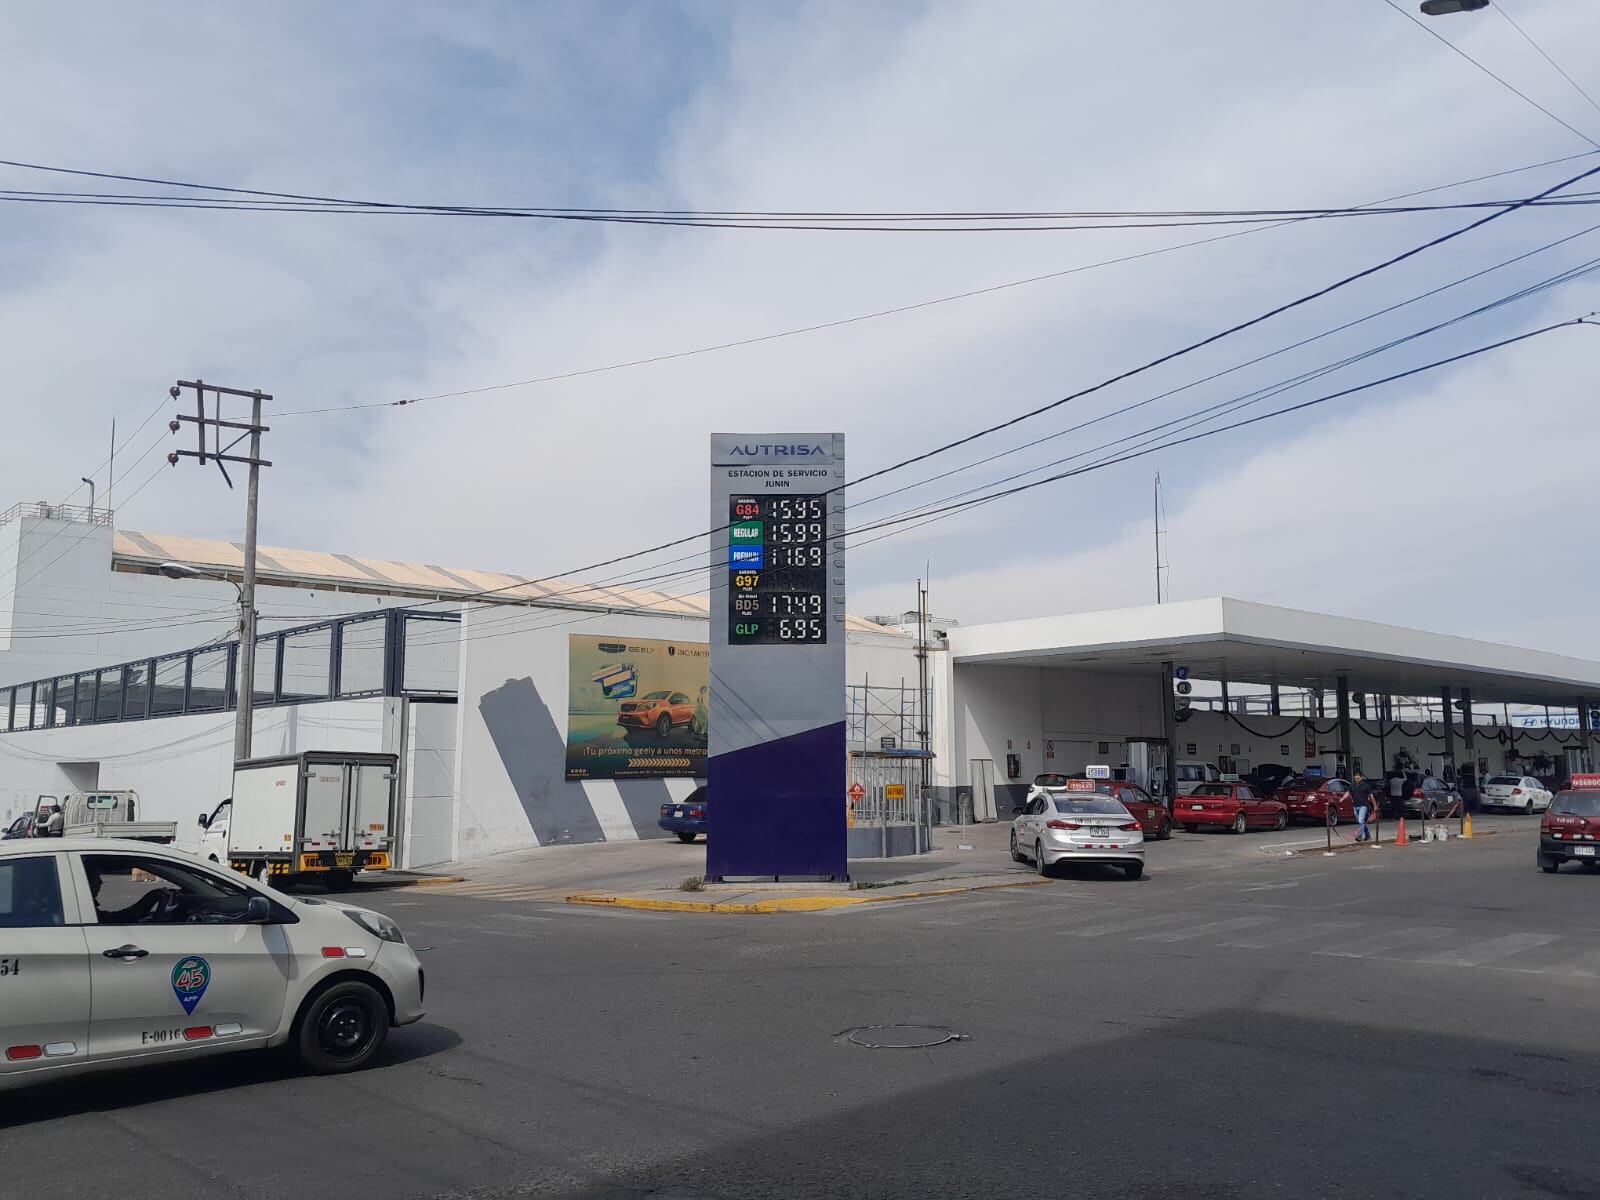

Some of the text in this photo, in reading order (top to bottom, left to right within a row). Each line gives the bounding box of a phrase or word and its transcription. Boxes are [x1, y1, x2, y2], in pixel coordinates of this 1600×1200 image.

[729, 444, 826, 456] AUTRISA
[728, 469, 828, 478] ESTACION DE SERVICIO
[765, 480, 790, 488] JUNIN
[736, 499, 821, 519] G84 15.95
[733, 523, 821, 543] REGULAR 15.99
[735, 575, 760, 587] G97
[735, 594, 821, 614] BD5 17.49
[735, 619, 821, 639] GLP 6.95
[628, 646, 656, 654] GEELY
[634, 746, 655, 757] geely
[176, 966, 205, 992] 45
